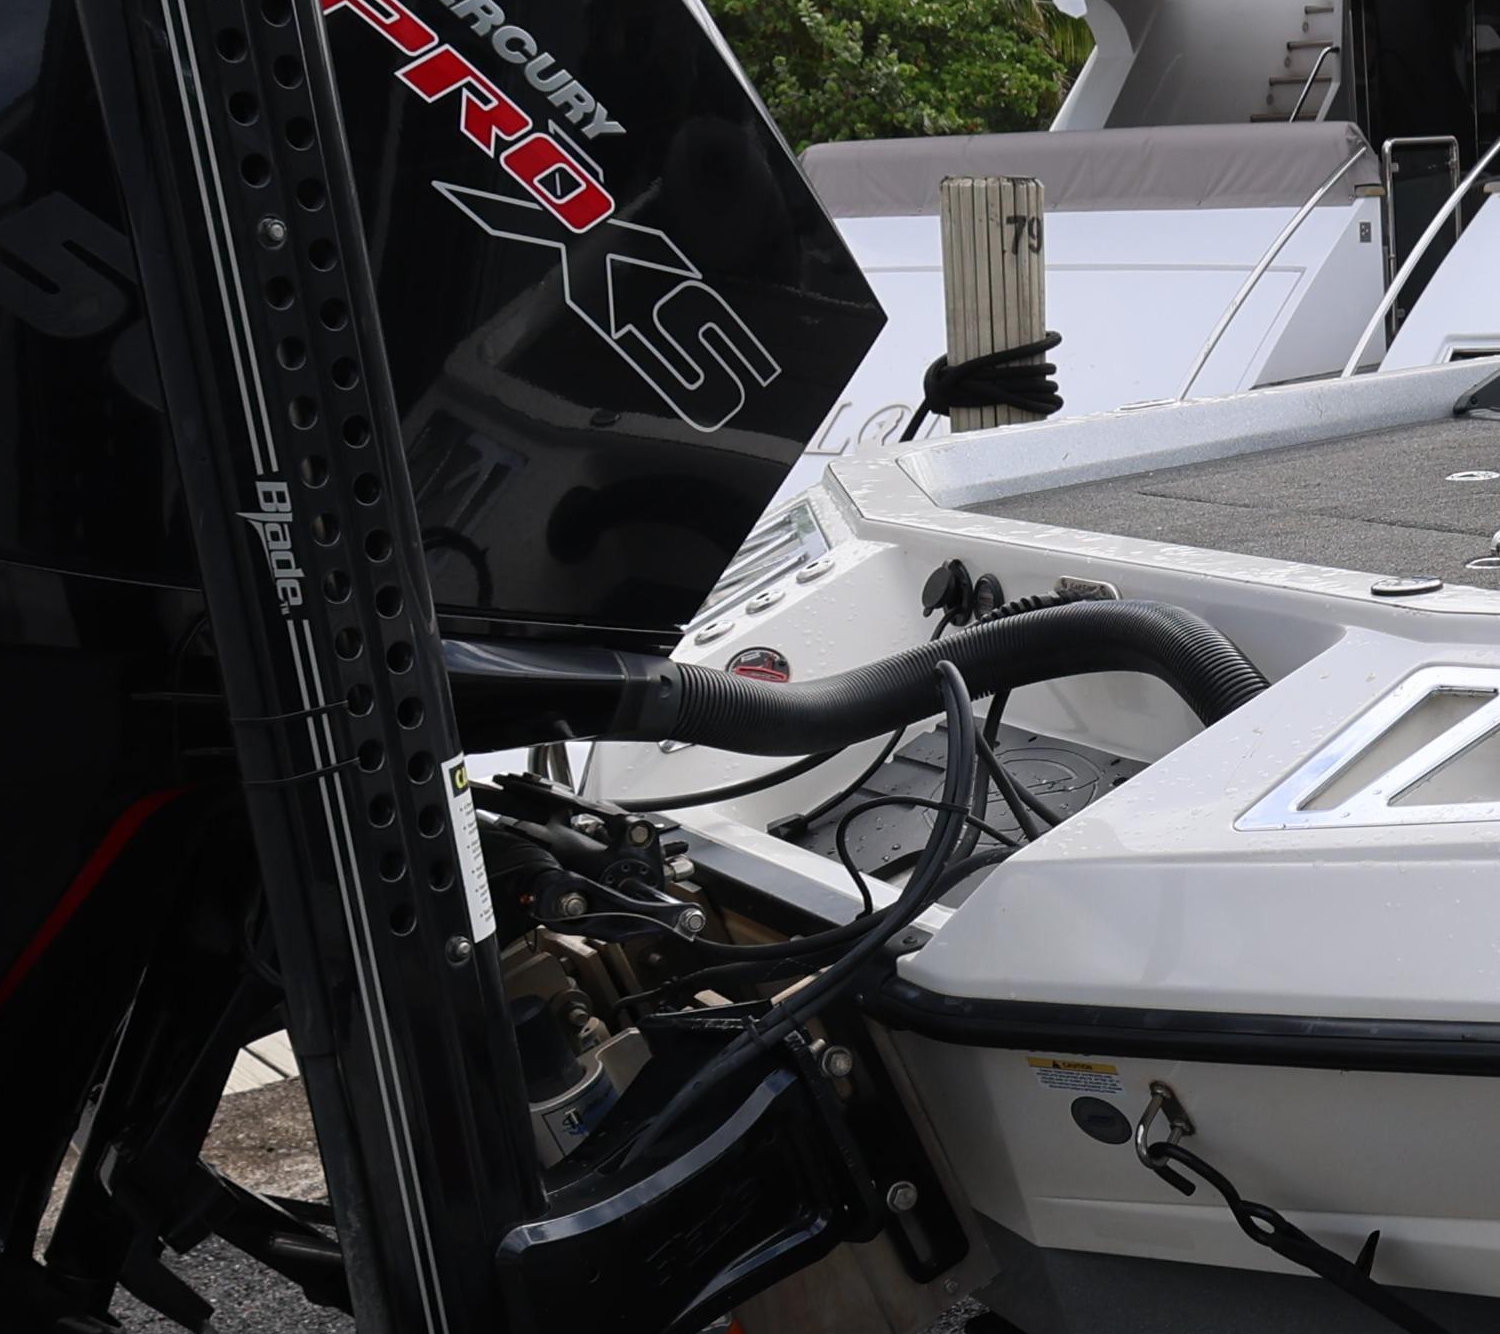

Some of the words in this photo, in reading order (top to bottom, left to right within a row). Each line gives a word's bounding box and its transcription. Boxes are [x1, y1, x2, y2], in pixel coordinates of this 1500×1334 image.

[431, 118, 782, 433] XS
[1005, 216, 1044, 255] 79
[235, 481, 306, 607] Blade
